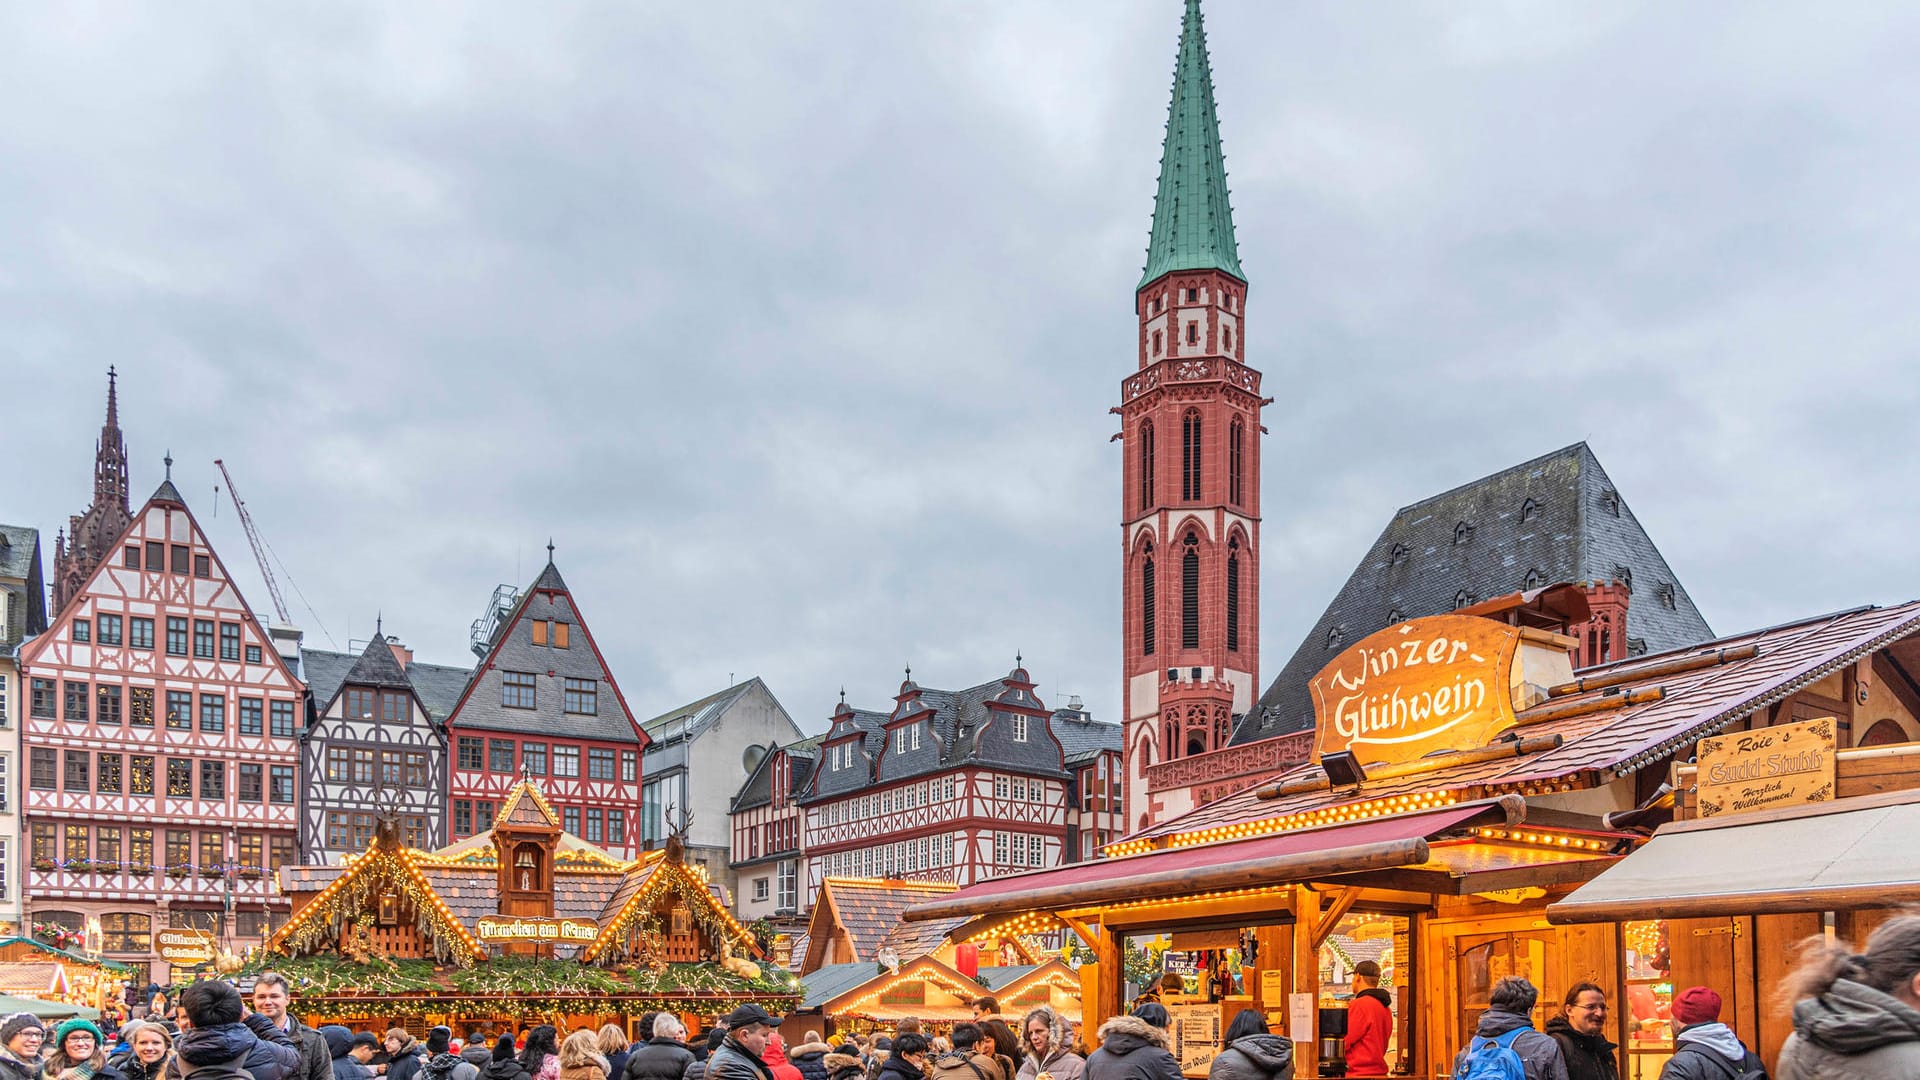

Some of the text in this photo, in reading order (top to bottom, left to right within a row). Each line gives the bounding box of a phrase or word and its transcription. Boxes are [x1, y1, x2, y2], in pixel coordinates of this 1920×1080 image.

[1335, 674, 1485, 744] Glühwein
[1732, 787, 1796, 811] Willkommen!
[1742, 780, 1782, 798] Herzlich
[539, 924, 557, 937] am
[562, 921, 598, 939] Römer
